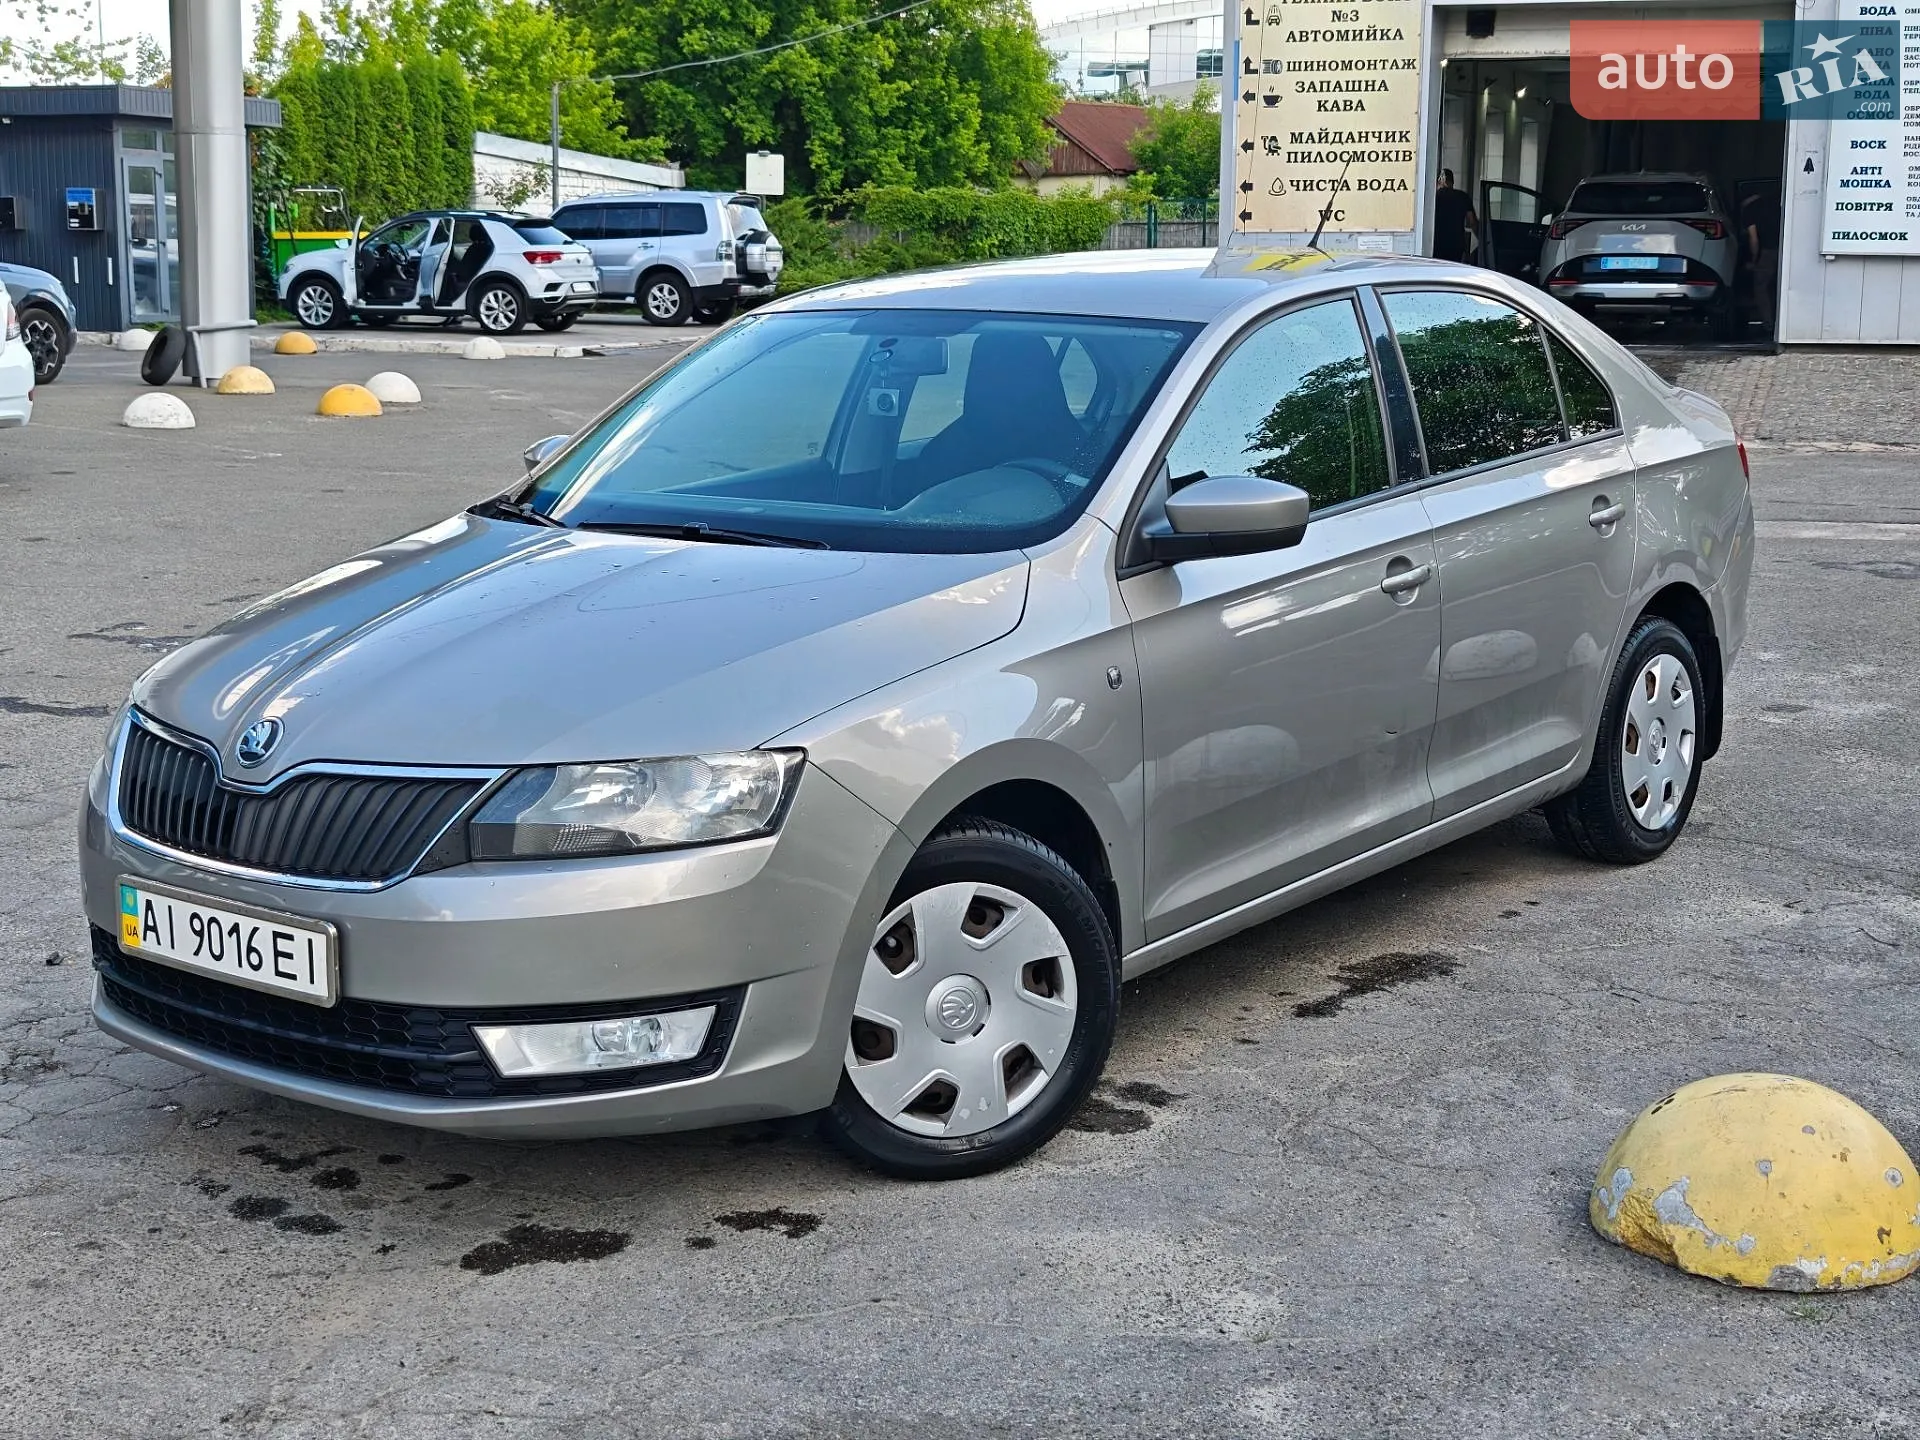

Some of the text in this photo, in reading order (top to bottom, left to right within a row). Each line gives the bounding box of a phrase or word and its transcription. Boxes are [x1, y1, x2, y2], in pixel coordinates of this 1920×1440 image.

[1331, 10, 1359, 22] №3
[1860, 6, 1896, 16] ВОДА
[1285, 25, 1404, 42] АВТОМИЙКА
[1860, 26, 1893, 36] ПІНА
[1287, 59, 1417, 72] ШИНОМОНТАЖ
[1295, 80, 1389, 93] ЗАПАШНА
[1854, 91, 1890, 100] ВОДА
[1317, 99, 1365, 112] КАВА
[1846, 111, 1894, 120] ОСМОС
[1290, 128, 1411, 146] МАЙДАНЧИК
[1850, 140, 1886, 149] ВОСК
[1286, 150, 1413, 163] ПИЛОСМОКІВ
[1850, 167, 1883, 175] АНТІ
[1289, 179, 1408, 192] ЧИСТА ВОДА
[1840, 179, 1891, 188] МОШКА
[1835, 202, 1893, 211] ПОВІТРЯ
[1832, 232, 1908, 240] ПИЛОСМОК
[126, 923, 139, 938] UA
[189, 911, 263, 972] 9016
